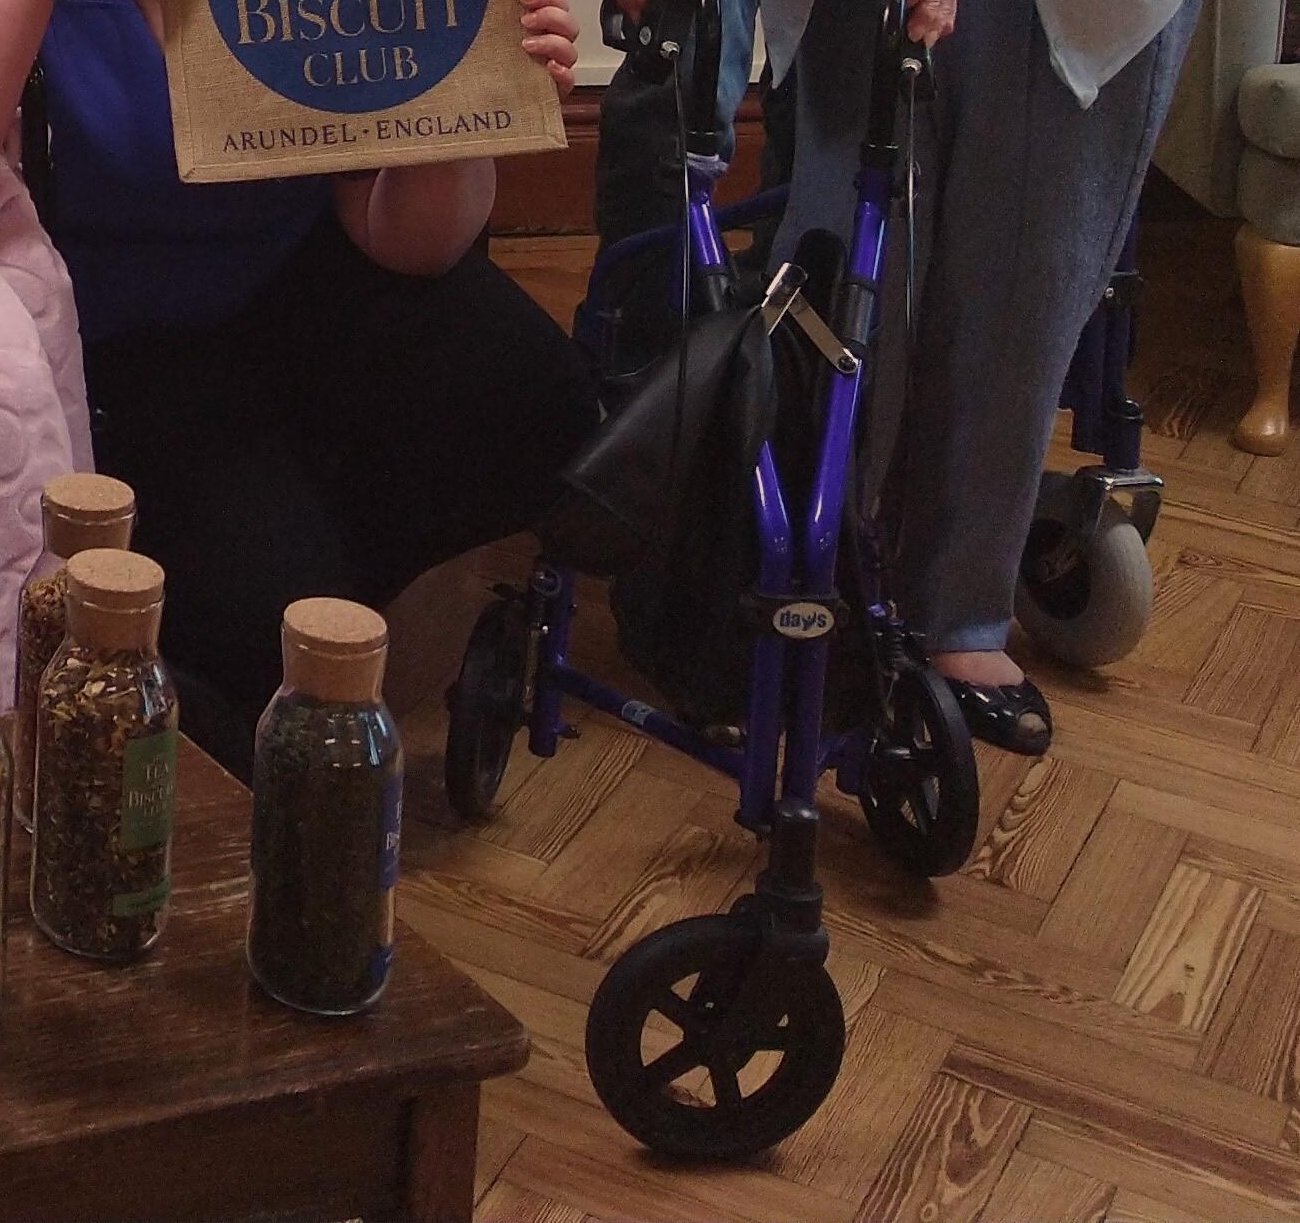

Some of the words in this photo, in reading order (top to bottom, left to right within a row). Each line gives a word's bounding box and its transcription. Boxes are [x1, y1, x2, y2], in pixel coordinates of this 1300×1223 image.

[303, 45, 420, 88] CLUB
[222, 123, 358, 153] ARUNDEL
[376, 109, 513, 140] ENGLAND
